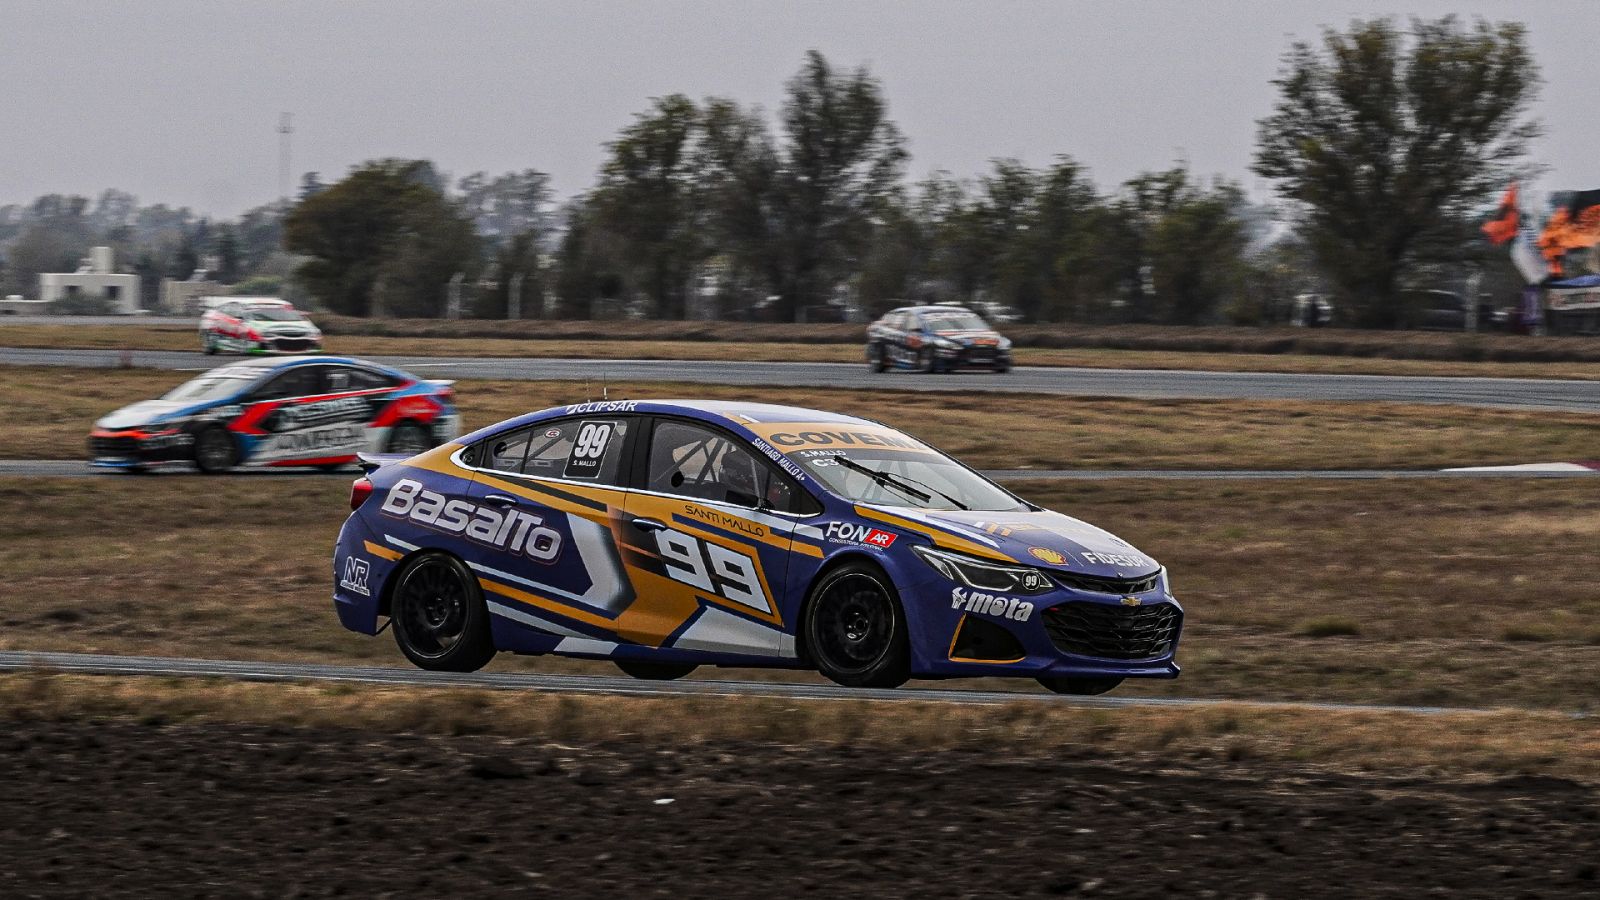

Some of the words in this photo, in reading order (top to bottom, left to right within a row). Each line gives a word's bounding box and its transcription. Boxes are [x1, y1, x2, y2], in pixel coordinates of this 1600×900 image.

[577, 402, 638, 412] CLIPSAR
[574, 424, 610, 458] 99
[752, 438, 781, 461] SANTIAGO
[778, 458, 800, 476] MALLO
[685, 504, 720, 523] SANTI
[723, 516, 764, 537] MALLO
[654, 527, 772, 614] 99
[1025, 575, 1038, 587] 99
[964, 591, 1034, 622] mota
